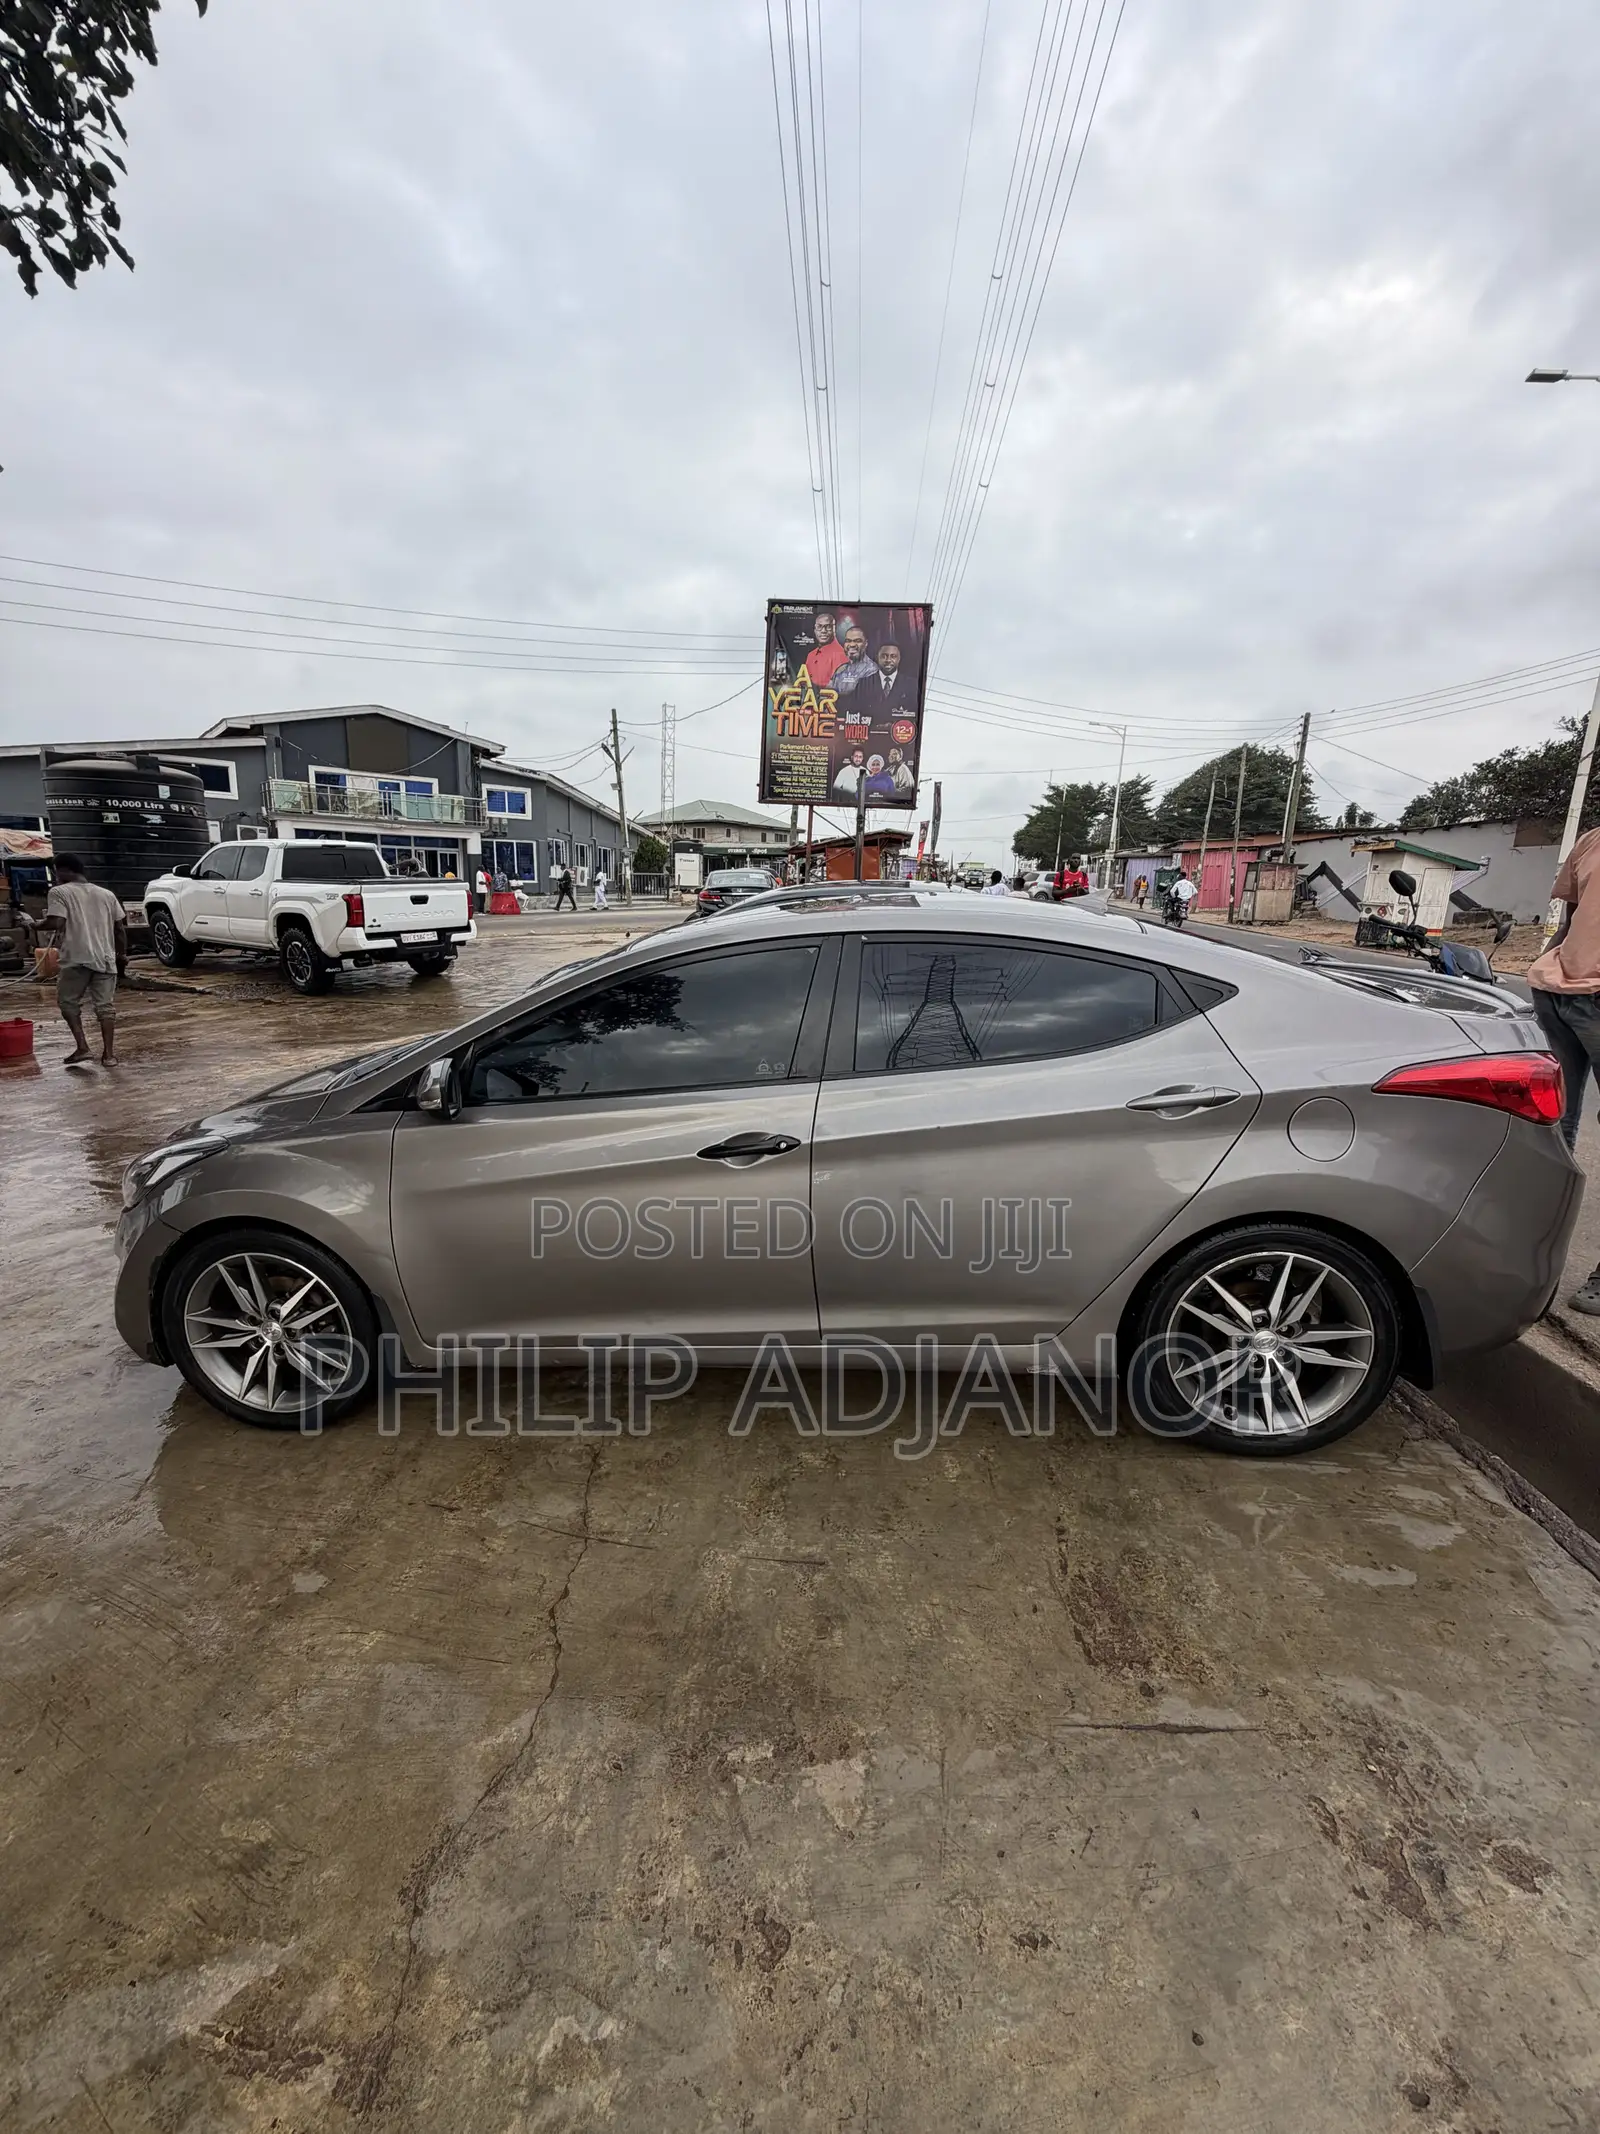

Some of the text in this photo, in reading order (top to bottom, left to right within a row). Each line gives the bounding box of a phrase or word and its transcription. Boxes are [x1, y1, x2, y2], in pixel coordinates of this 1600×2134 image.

[793, 664, 812, 688] A
[768, 686, 839, 713] YEAR
[771, 711, 836, 737] TIME
[845, 710, 872, 726] Just say
[845, 725, 868, 740] WORD
[896, 726, 913, 734] 12-1
[106, 799, 142, 808] 10,000
[144, 802, 164, 810] Ltrs
[384, 909, 455, 920] TACOMA
